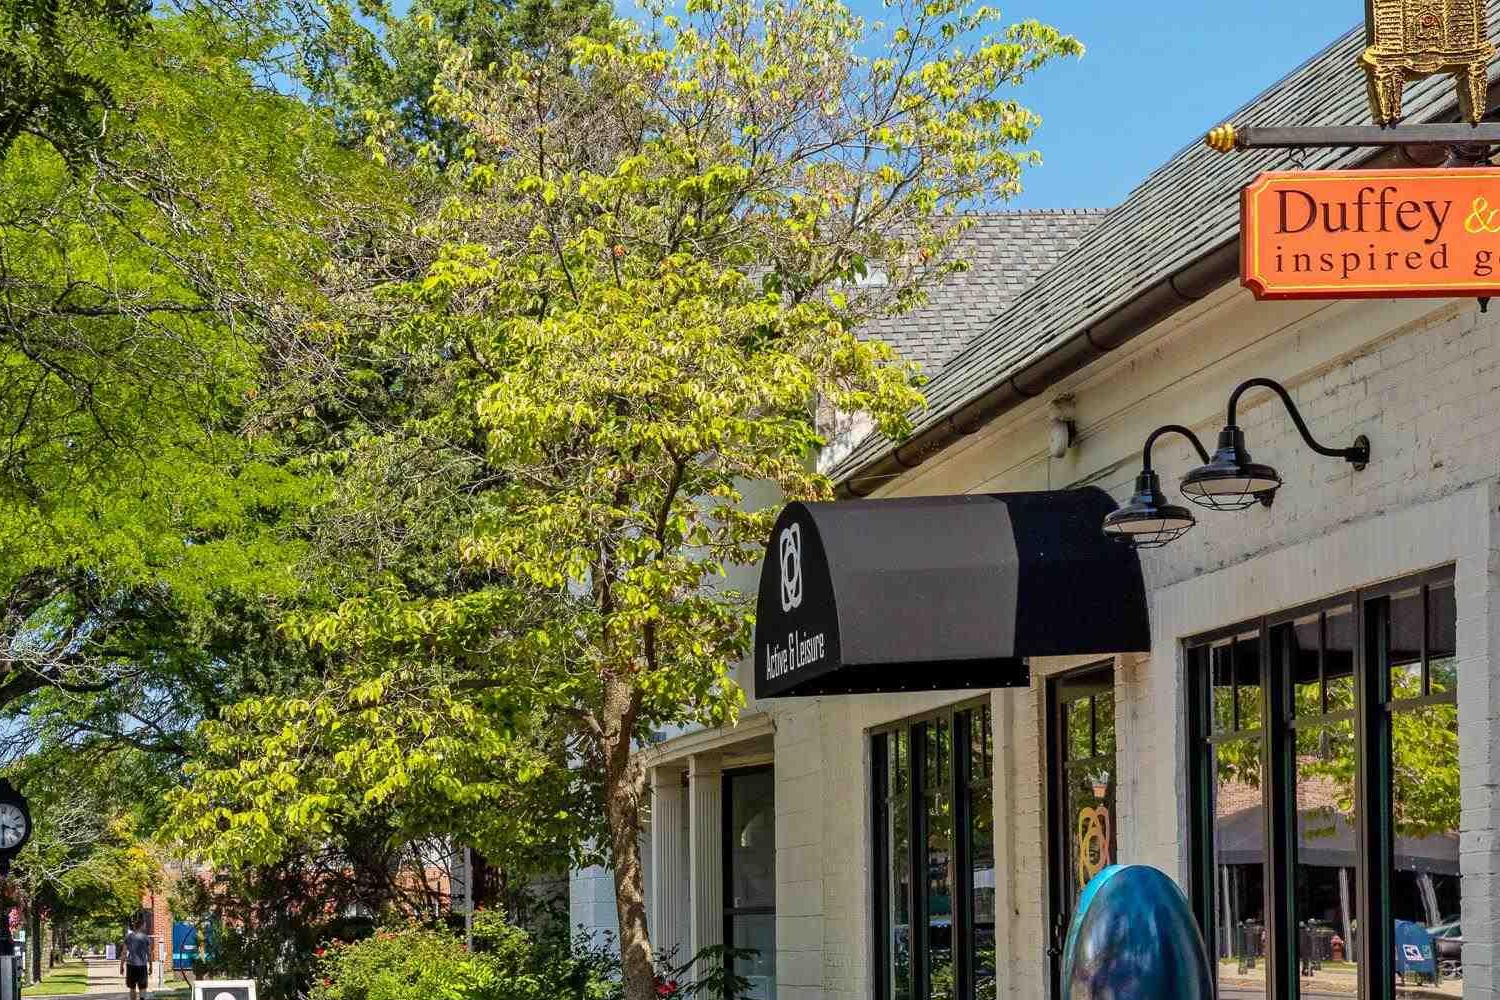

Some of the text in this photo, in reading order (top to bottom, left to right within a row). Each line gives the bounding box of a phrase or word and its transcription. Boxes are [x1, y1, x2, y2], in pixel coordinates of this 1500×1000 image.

[1275, 186, 1500, 244] Duffey &
[1275, 244, 1449, 280] inspired
[766, 630, 825, 681] Active & Leisure
